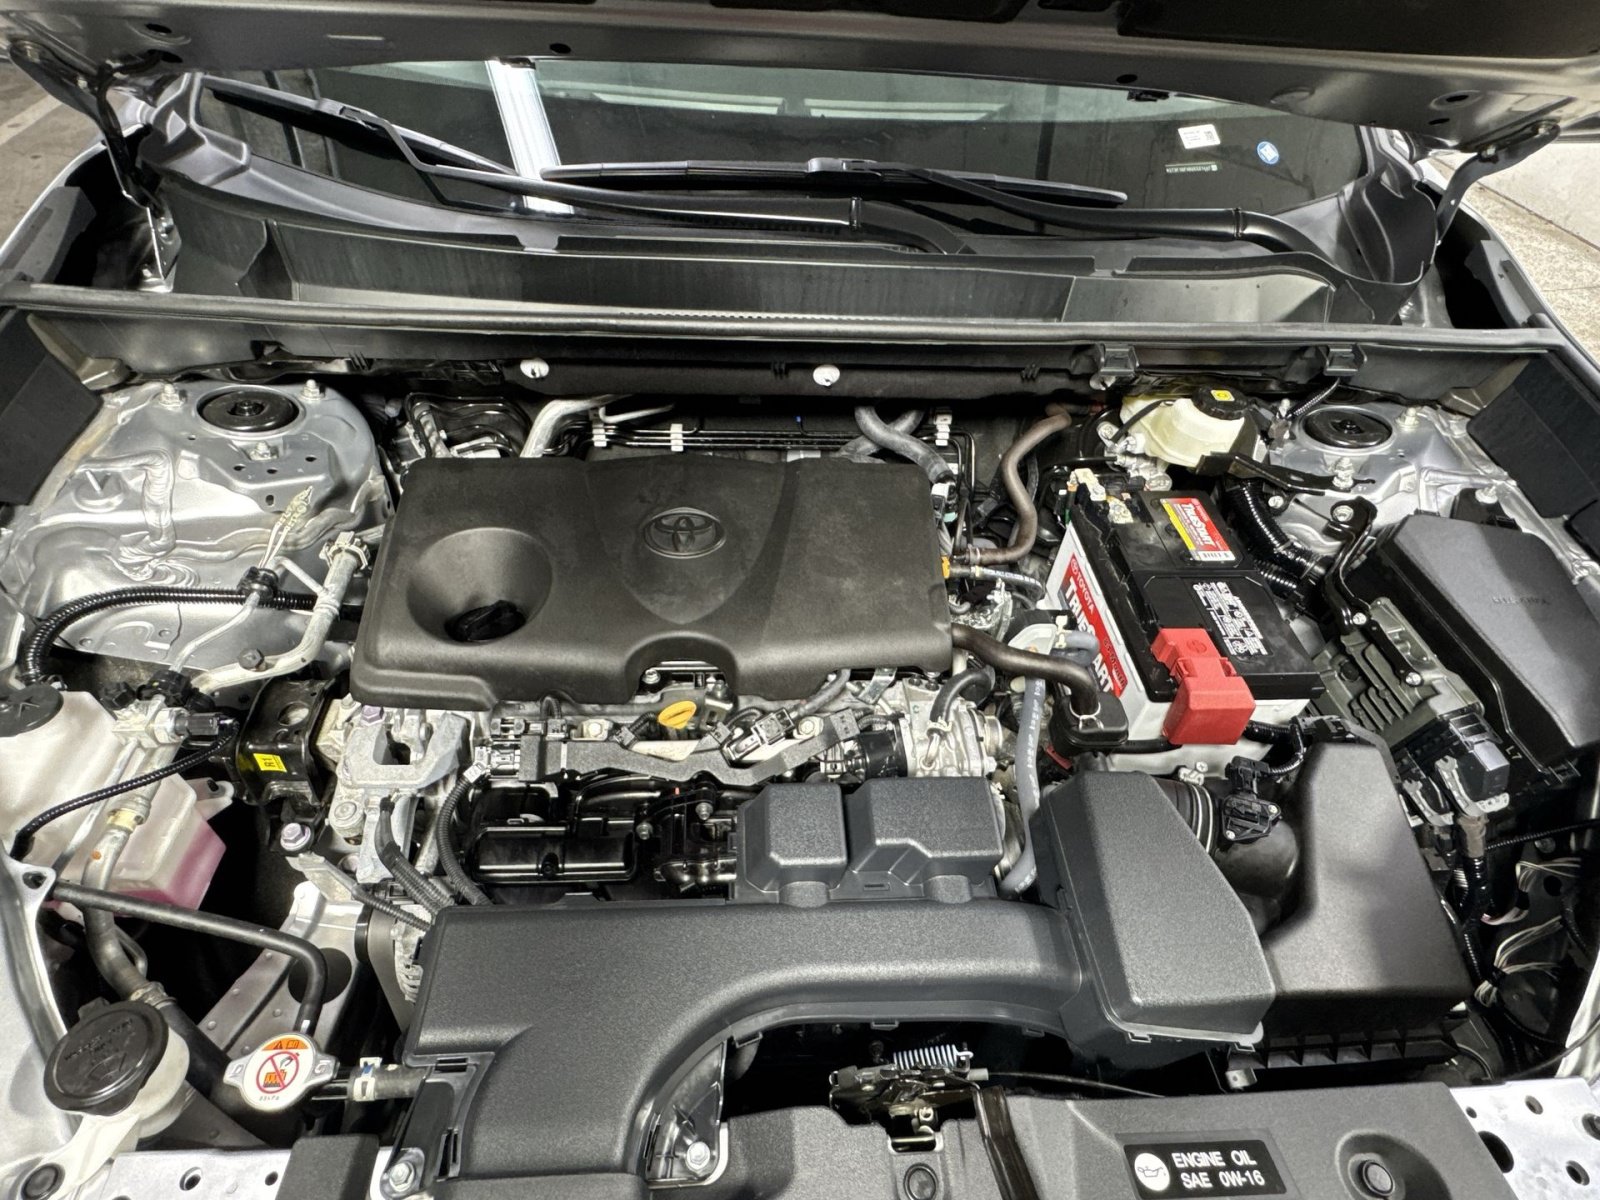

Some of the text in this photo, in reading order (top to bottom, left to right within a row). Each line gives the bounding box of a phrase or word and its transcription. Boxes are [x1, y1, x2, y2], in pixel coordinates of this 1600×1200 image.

[1077, 571, 1095, 614] TOYOTA
[1505, 745, 1522, 759] L7
[1171, 1150, 1257, 1168] ENGINE OIL
[1180, 1169, 1265, 1189] SAE 0W-16
